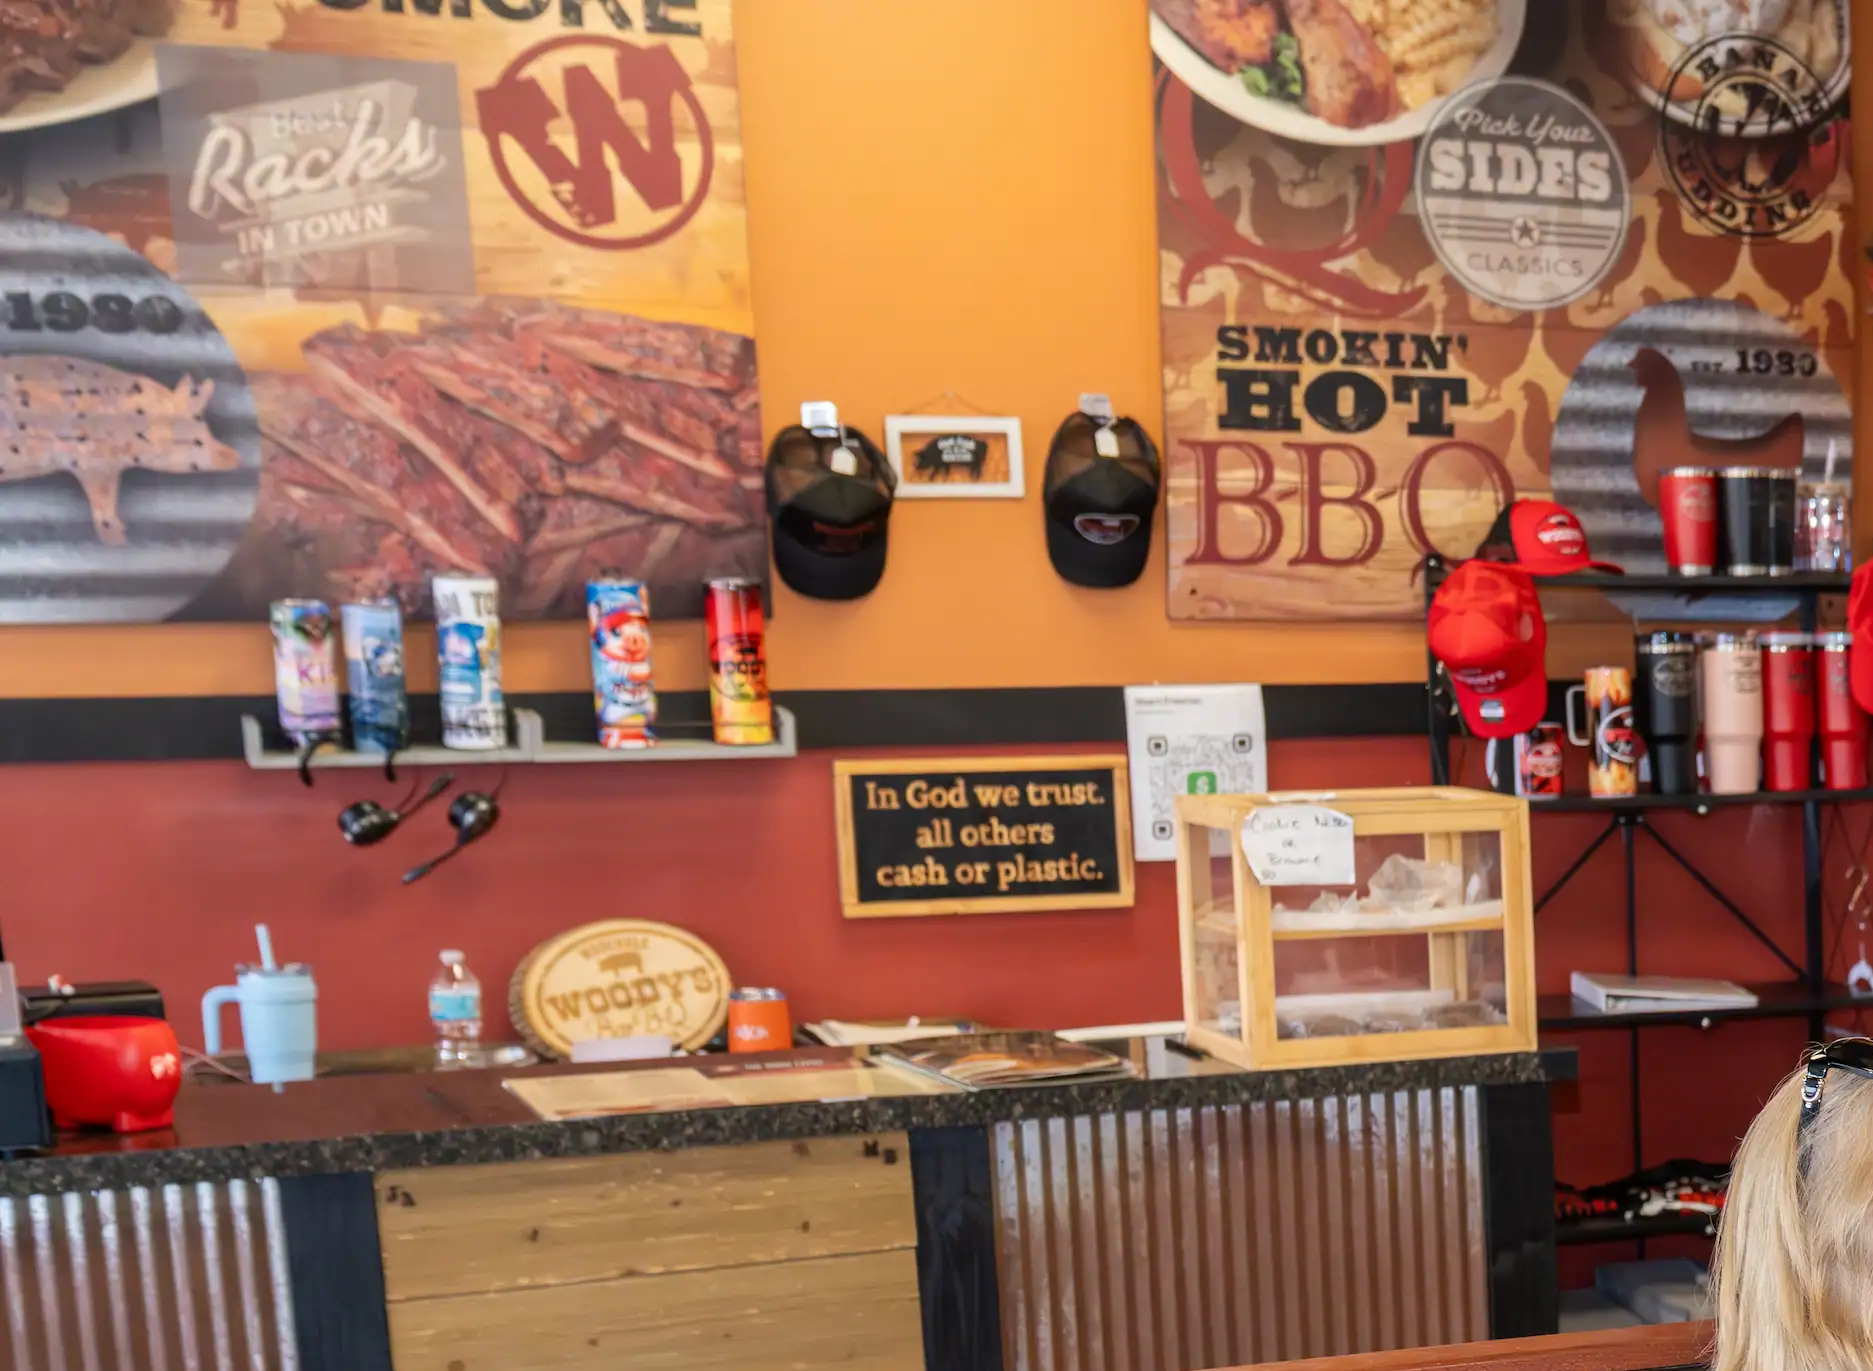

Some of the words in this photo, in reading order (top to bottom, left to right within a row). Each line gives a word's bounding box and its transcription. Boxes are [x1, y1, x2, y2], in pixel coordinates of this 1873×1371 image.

[1454, 106, 1522, 137] Pick
[1524, 113, 1596, 145] Your
[188, 100, 448, 220] Racks
[1430, 138, 1612, 202] SIDES
[238, 228, 275, 255] IN
[284, 204, 390, 245] TOWN
[1467, 252, 1583, 277] CLASSICS
[1216, 325, 1468, 370] SMOKIN'
[1217, 368, 1468, 438] HOT
[1178, 439, 1516, 588] BBQ
[865, 781, 899, 810] In
[905, 777, 968, 809] God
[974, 784, 1019, 807] we
[1026, 779, 1105, 806] trust.
[916, 818, 954, 848] all
[960, 818, 1055, 847] others
[876, 856, 948, 887] cash
[956, 859, 989, 883] or
[997, 852, 1104, 891] plastic.
